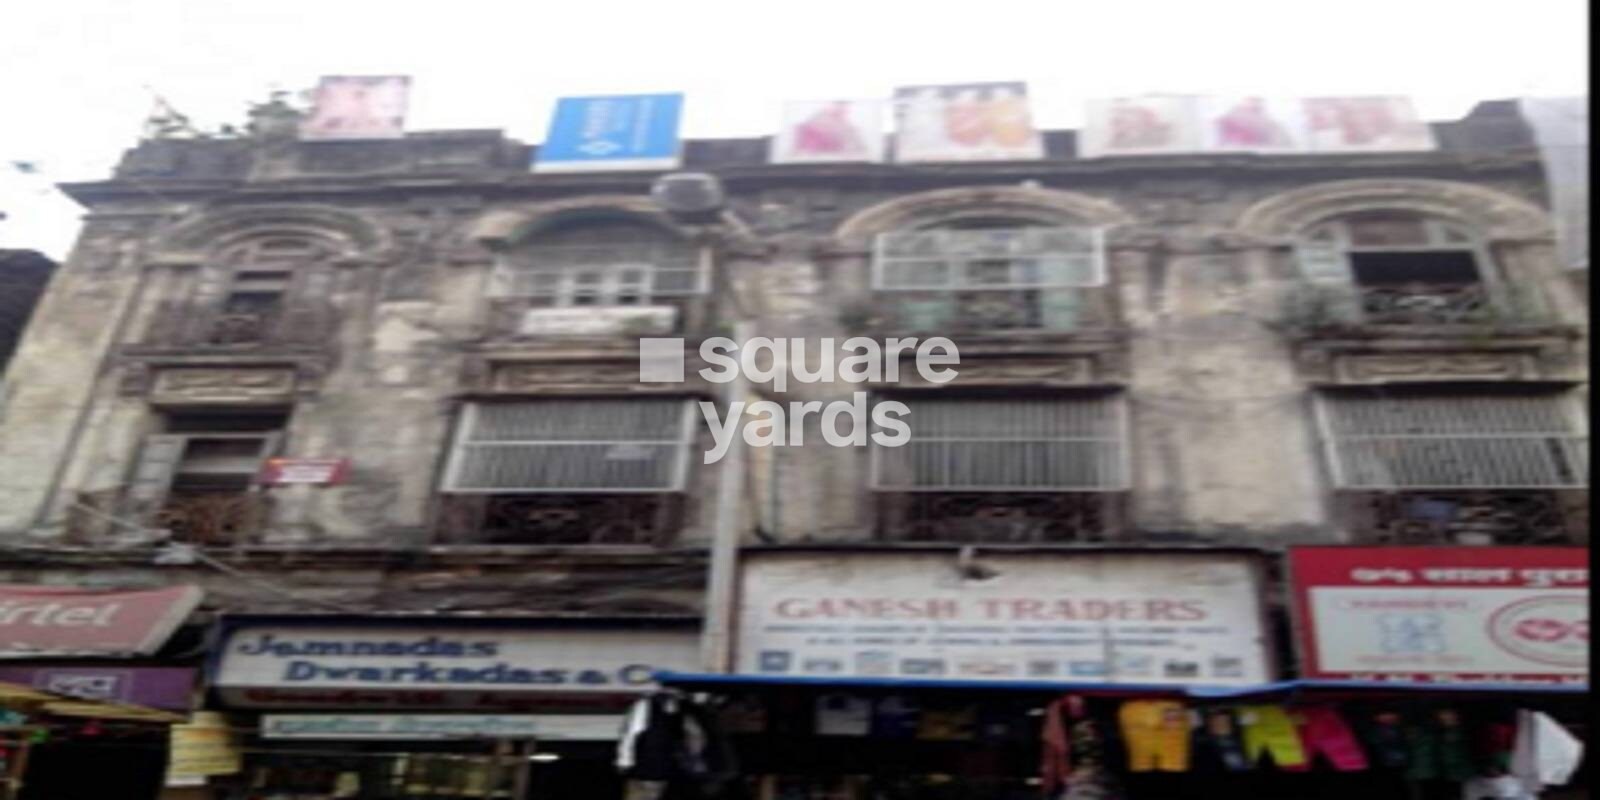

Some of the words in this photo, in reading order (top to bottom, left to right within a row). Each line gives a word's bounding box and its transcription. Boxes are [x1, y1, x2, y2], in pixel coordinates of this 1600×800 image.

[775, 597, 960, 620] GANESH
[976, 597, 1209, 621] TRADERS
[238, 634, 499, 658] Jamnadas
[284, 661, 565, 684] Dwarkadas
[617, 664, 655, 685] C
